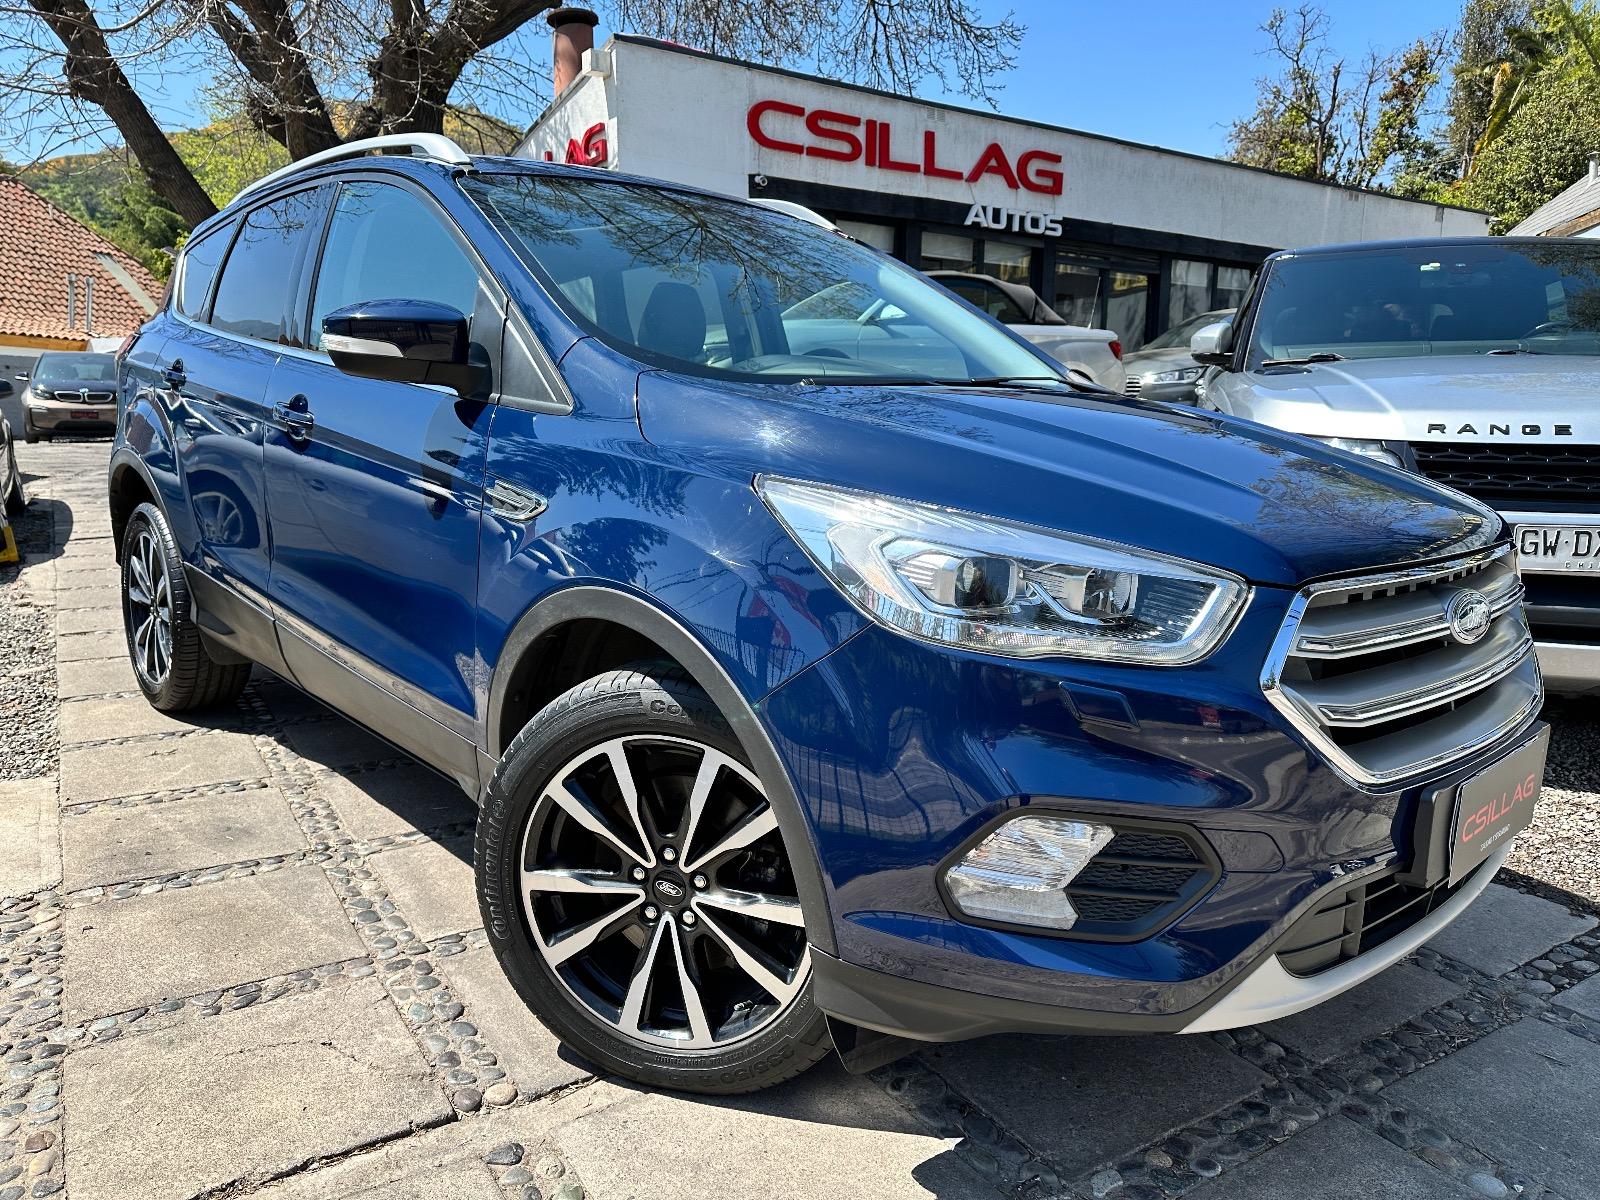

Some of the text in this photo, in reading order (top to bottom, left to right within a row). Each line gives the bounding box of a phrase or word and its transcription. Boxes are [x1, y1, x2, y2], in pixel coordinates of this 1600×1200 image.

[747, 100, 1064, 196] CSILLAG
[963, 201, 1063, 237] AUTOS
[1427, 423, 1573, 436] RANGE
[1462, 773, 1535, 842] CSILLAG
